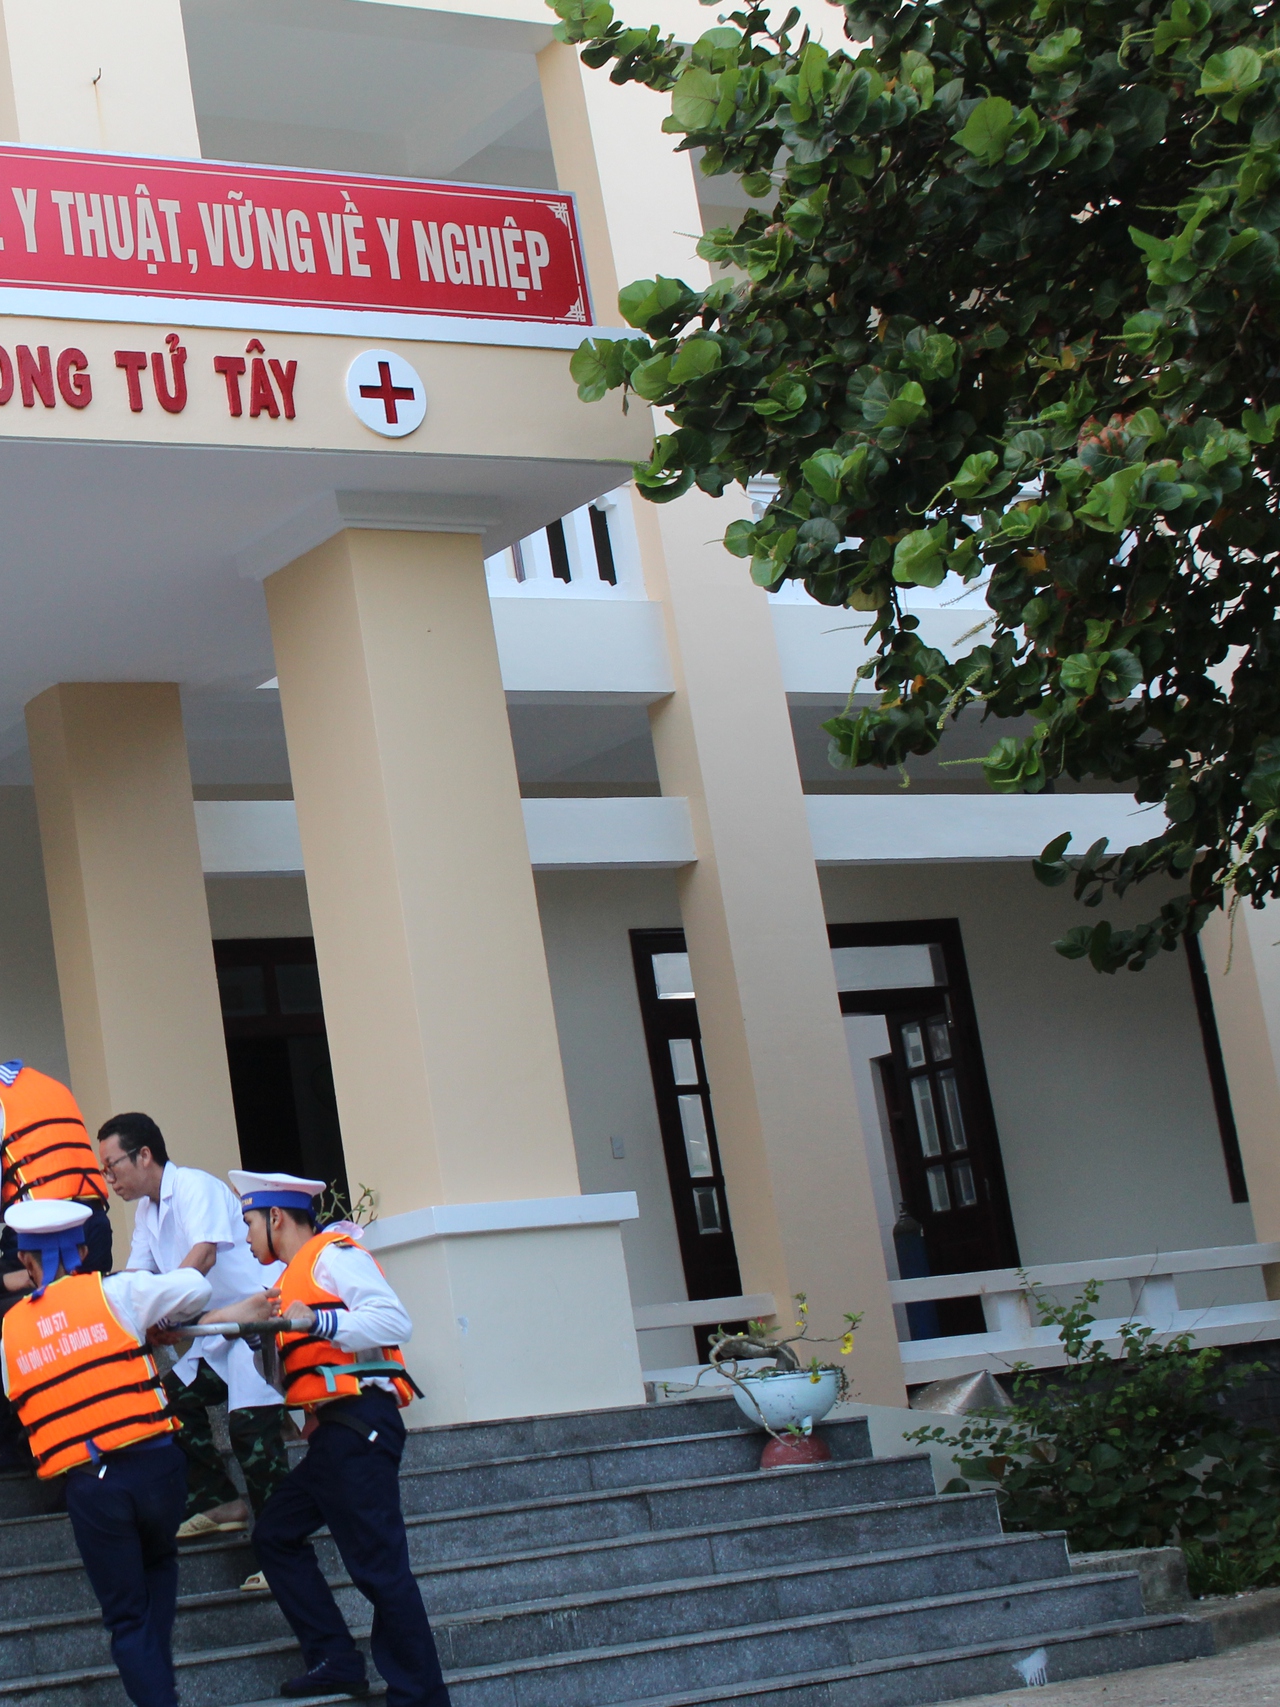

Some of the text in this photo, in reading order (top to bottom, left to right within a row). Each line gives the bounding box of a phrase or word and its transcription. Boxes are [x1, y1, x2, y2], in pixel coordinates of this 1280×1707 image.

[12, 186, 37, 253] Y
[51, 183, 198, 274] THUẬT,
[198, 190, 317, 274] VỮNG
[317, 190, 372, 278] VỀ
[376, 217, 401, 280] Y
[412, 216, 550, 300] NGHIỆP
[114, 333, 188, 414] TỬ
[213, 338, 297, 419] TÂY
[36, 1310, 68, 1339] TÀU 571
